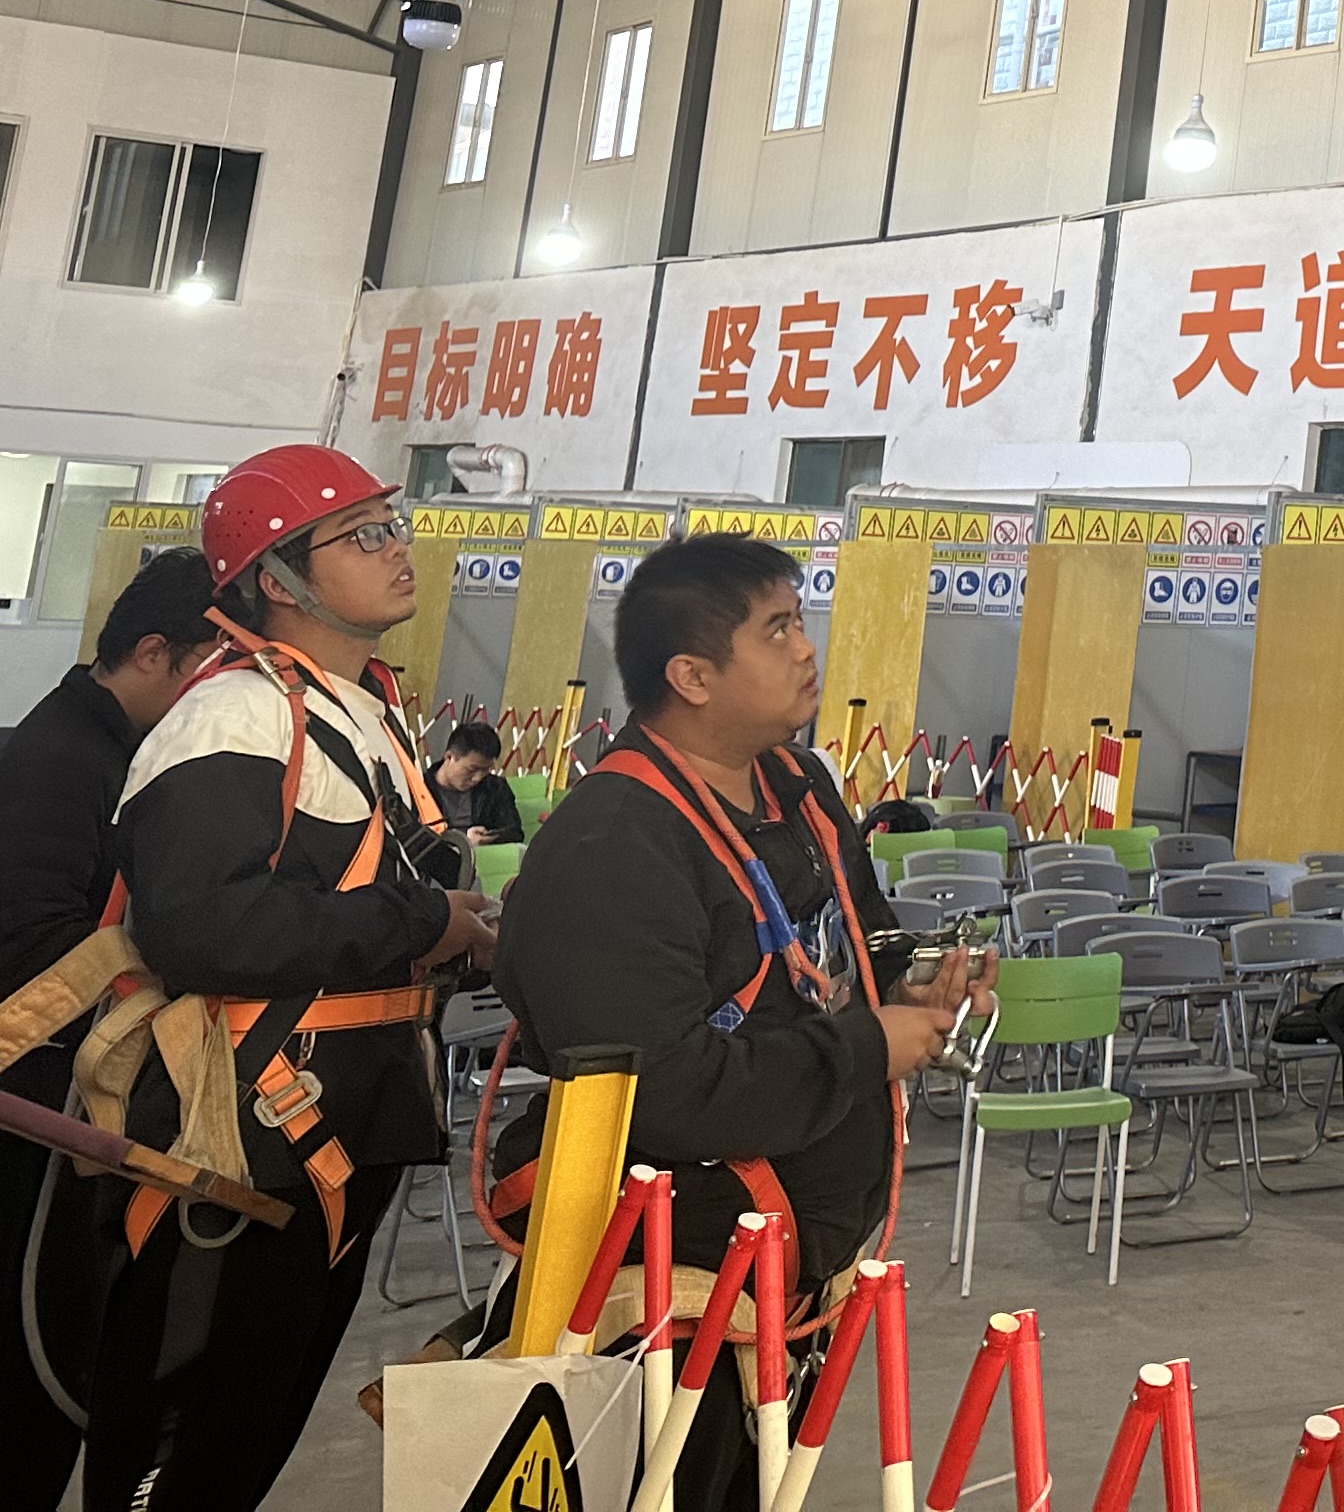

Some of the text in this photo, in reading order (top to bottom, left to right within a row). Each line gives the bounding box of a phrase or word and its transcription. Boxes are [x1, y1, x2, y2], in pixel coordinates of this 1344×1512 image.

[372, 311, 602, 422] 目标明确
[691, 279, 1024, 415] 坚定不移
